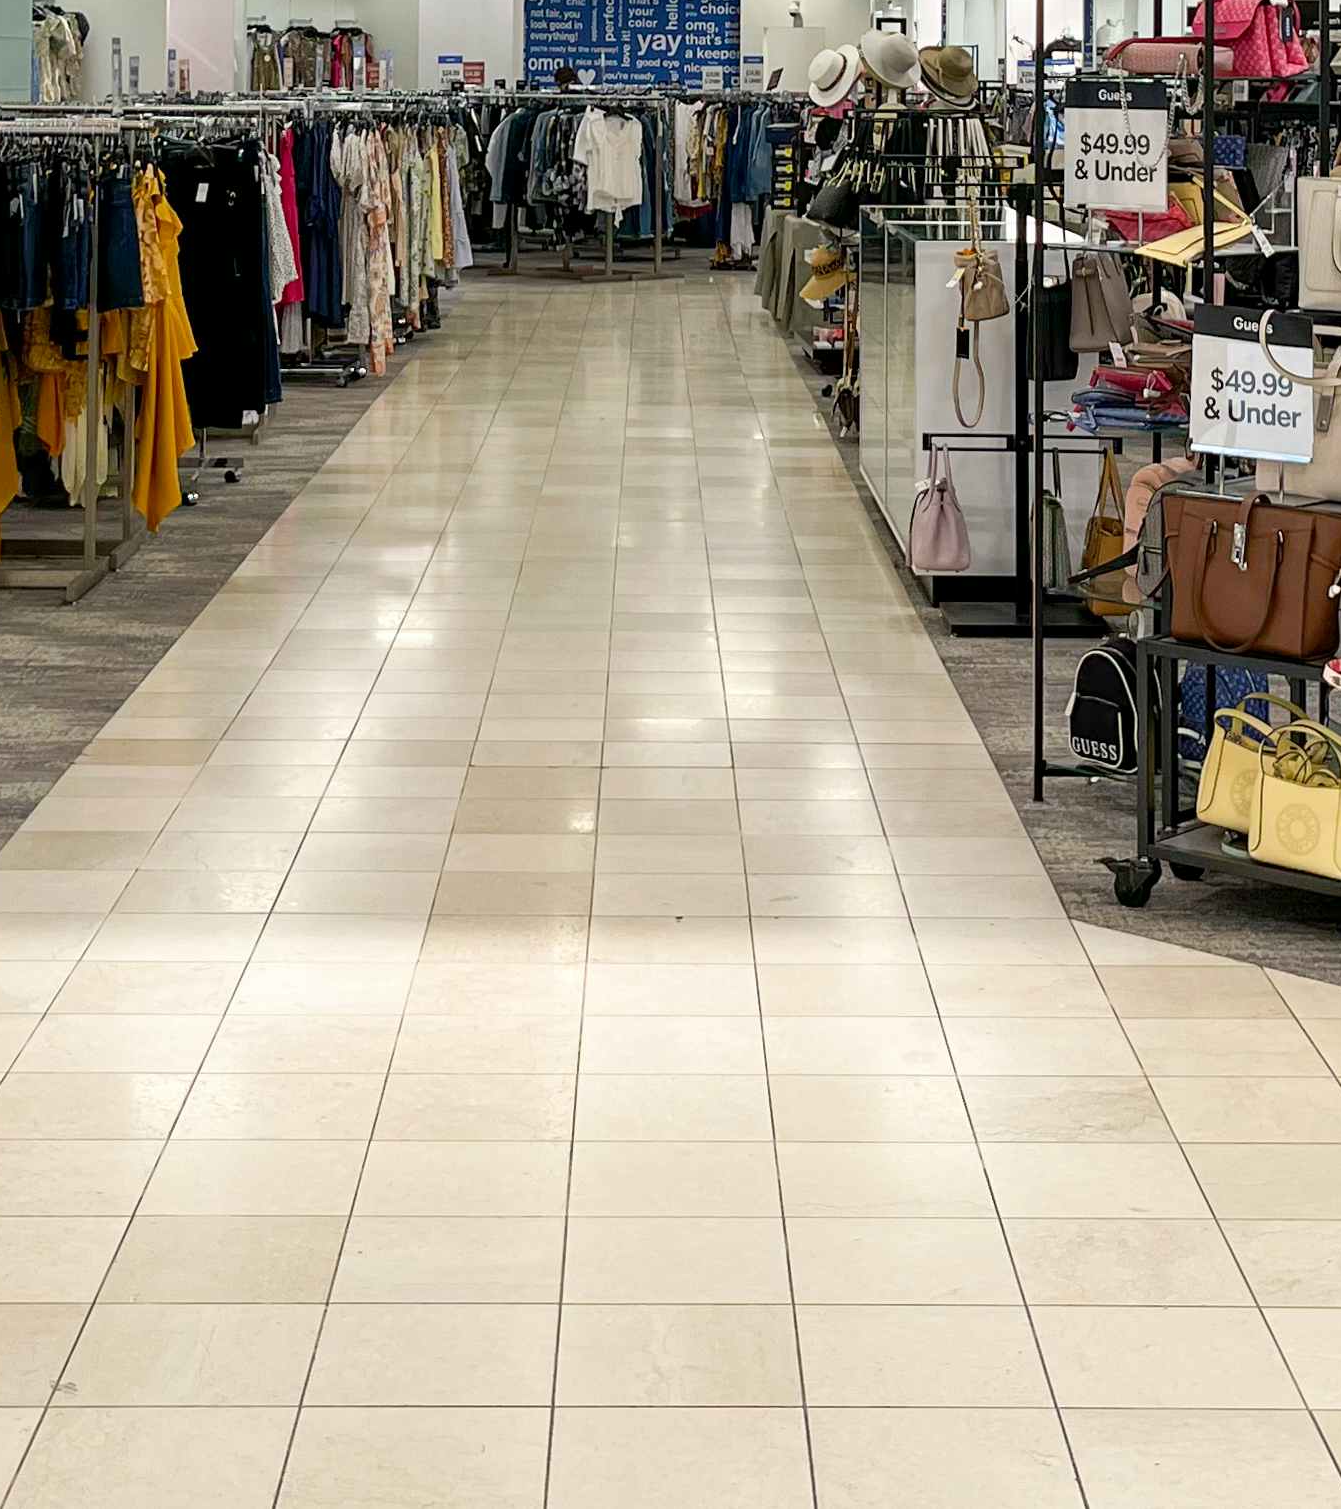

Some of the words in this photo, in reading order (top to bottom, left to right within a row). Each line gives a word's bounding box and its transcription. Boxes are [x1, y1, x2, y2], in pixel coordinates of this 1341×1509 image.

[628, 7, 655, 18] your
[627, 18, 658, 29] color
[684, 20, 719, 34] omg,
[636, 33, 683, 57] yay
[684, 33, 722, 46] that's
[684, 48, 693, 59] a
[635, 58, 660, 69] good
[1080, 132, 1151, 157] $49.99
[1074, 158, 1089, 180] &
[1094, 159, 1158, 183] Under
[1233, 316, 1274, 335] Gues
[1210, 366, 1294, 398] $49.99
[1203, 396, 1221, 421] &
[1227, 398, 1303, 429] Under
[1071, 736, 1118, 762] GUESS
